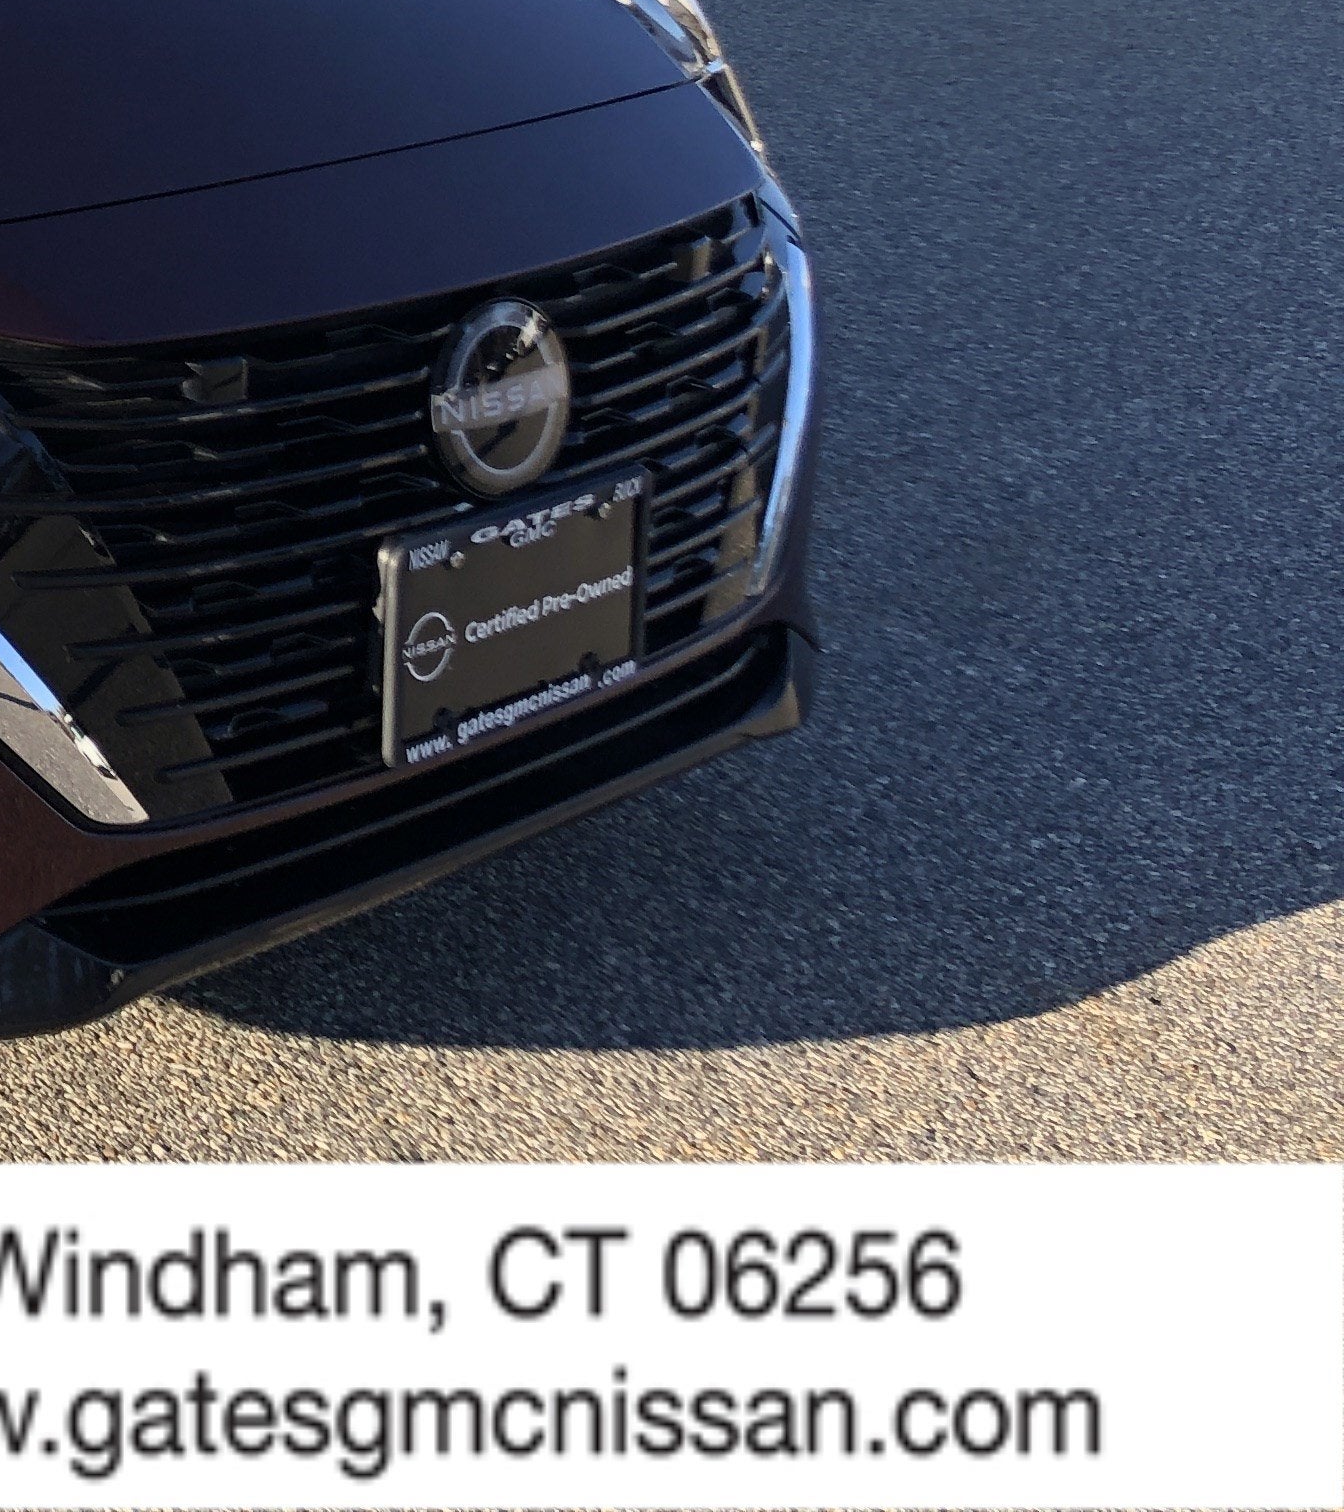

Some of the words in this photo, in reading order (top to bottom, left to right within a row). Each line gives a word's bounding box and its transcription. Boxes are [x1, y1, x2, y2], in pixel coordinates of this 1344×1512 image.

[439, 373, 559, 425] NISSA
[470, 493, 595, 544] GATES
[509, 519, 557, 548] GMC
[408, 539, 451, 570] NISSAN
[464, 599, 540, 643] Certified
[541, 565, 634, 617] Pre-Owned
[402, 634, 457, 659] NISSAN
